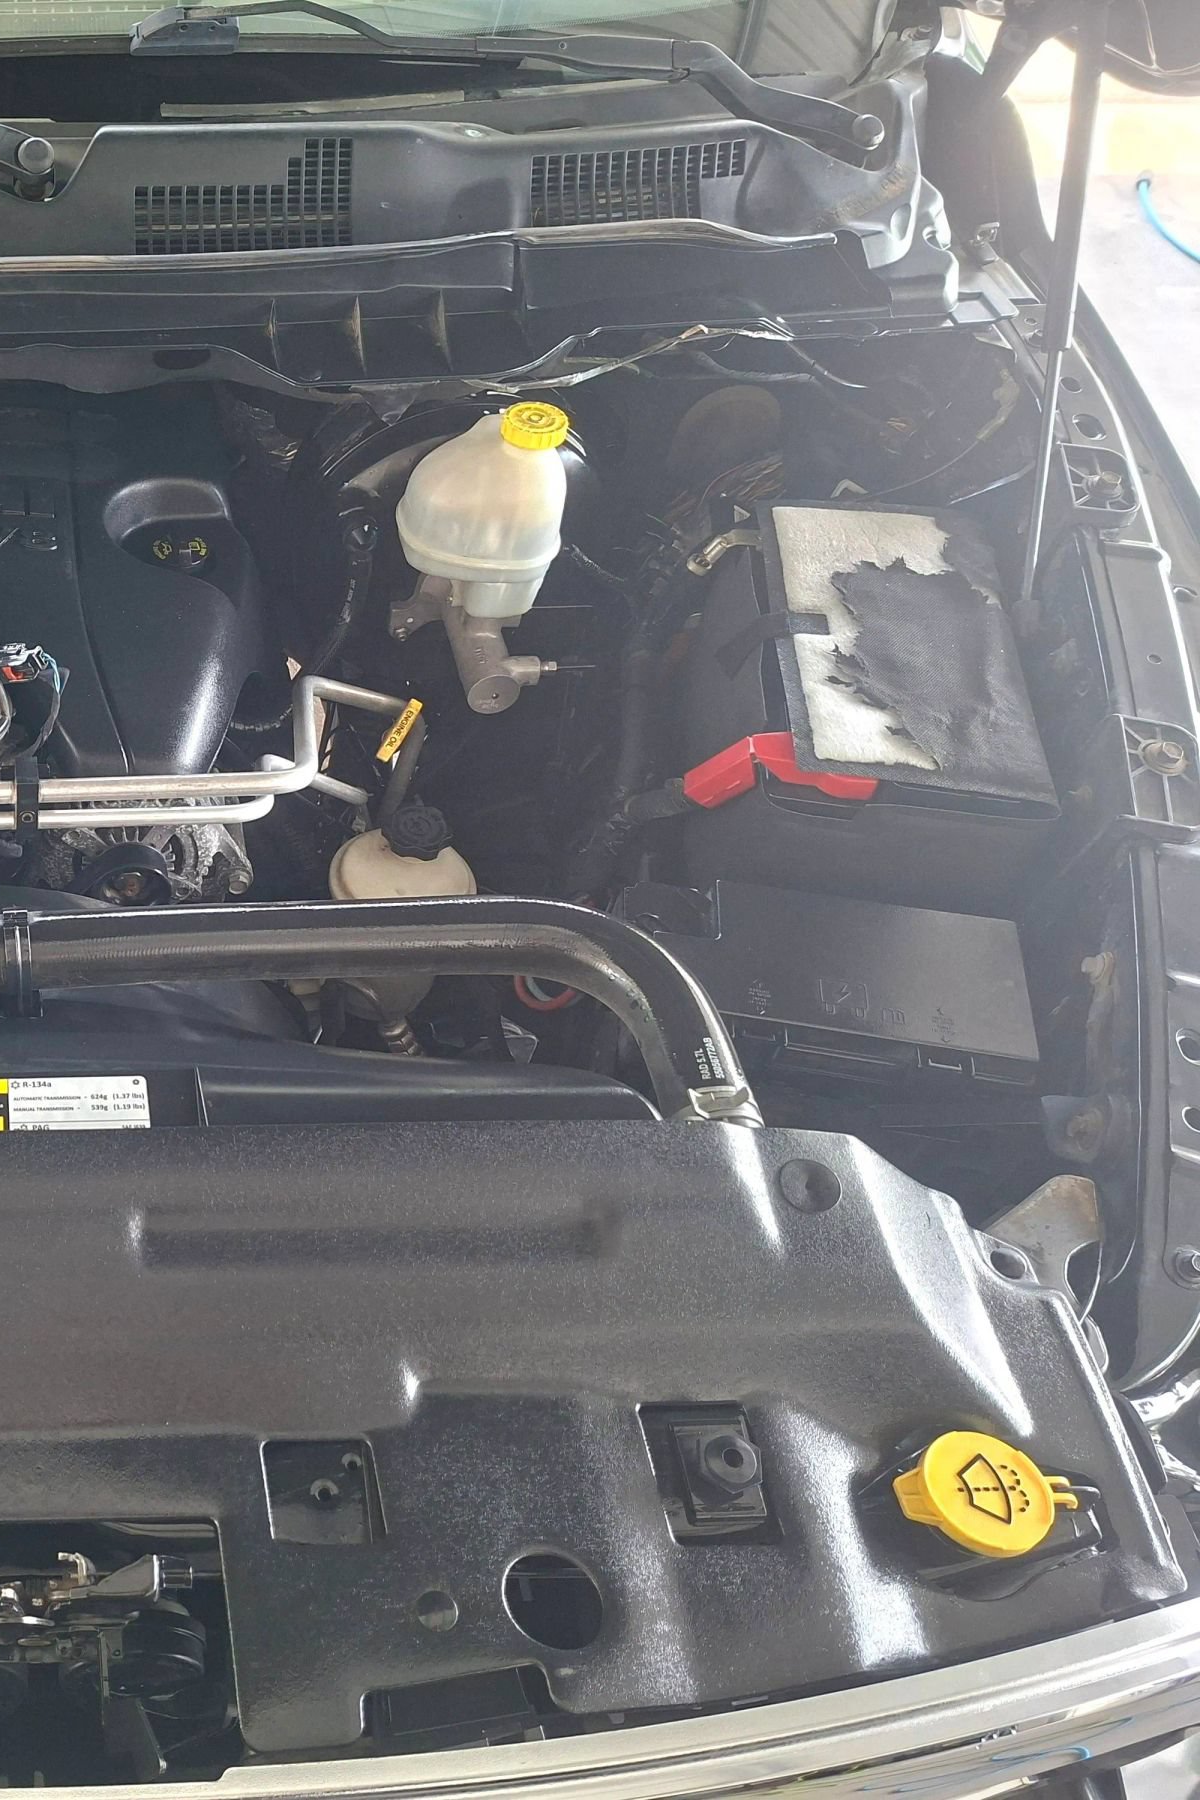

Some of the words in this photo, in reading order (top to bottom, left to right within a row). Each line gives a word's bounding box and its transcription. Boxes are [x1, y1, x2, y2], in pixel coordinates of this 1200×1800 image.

[394, 710, 414, 736] ENGINE
[385, 736, 397, 748] OIL
[698, 1064, 712, 1080] RAD
[90, 1093, 108, 1101] 624g
[112, 1093, 130, 1101] (1.37
[132, 1092, 145, 1100] lbs)
[91, 1104, 108, 1112] 539g
